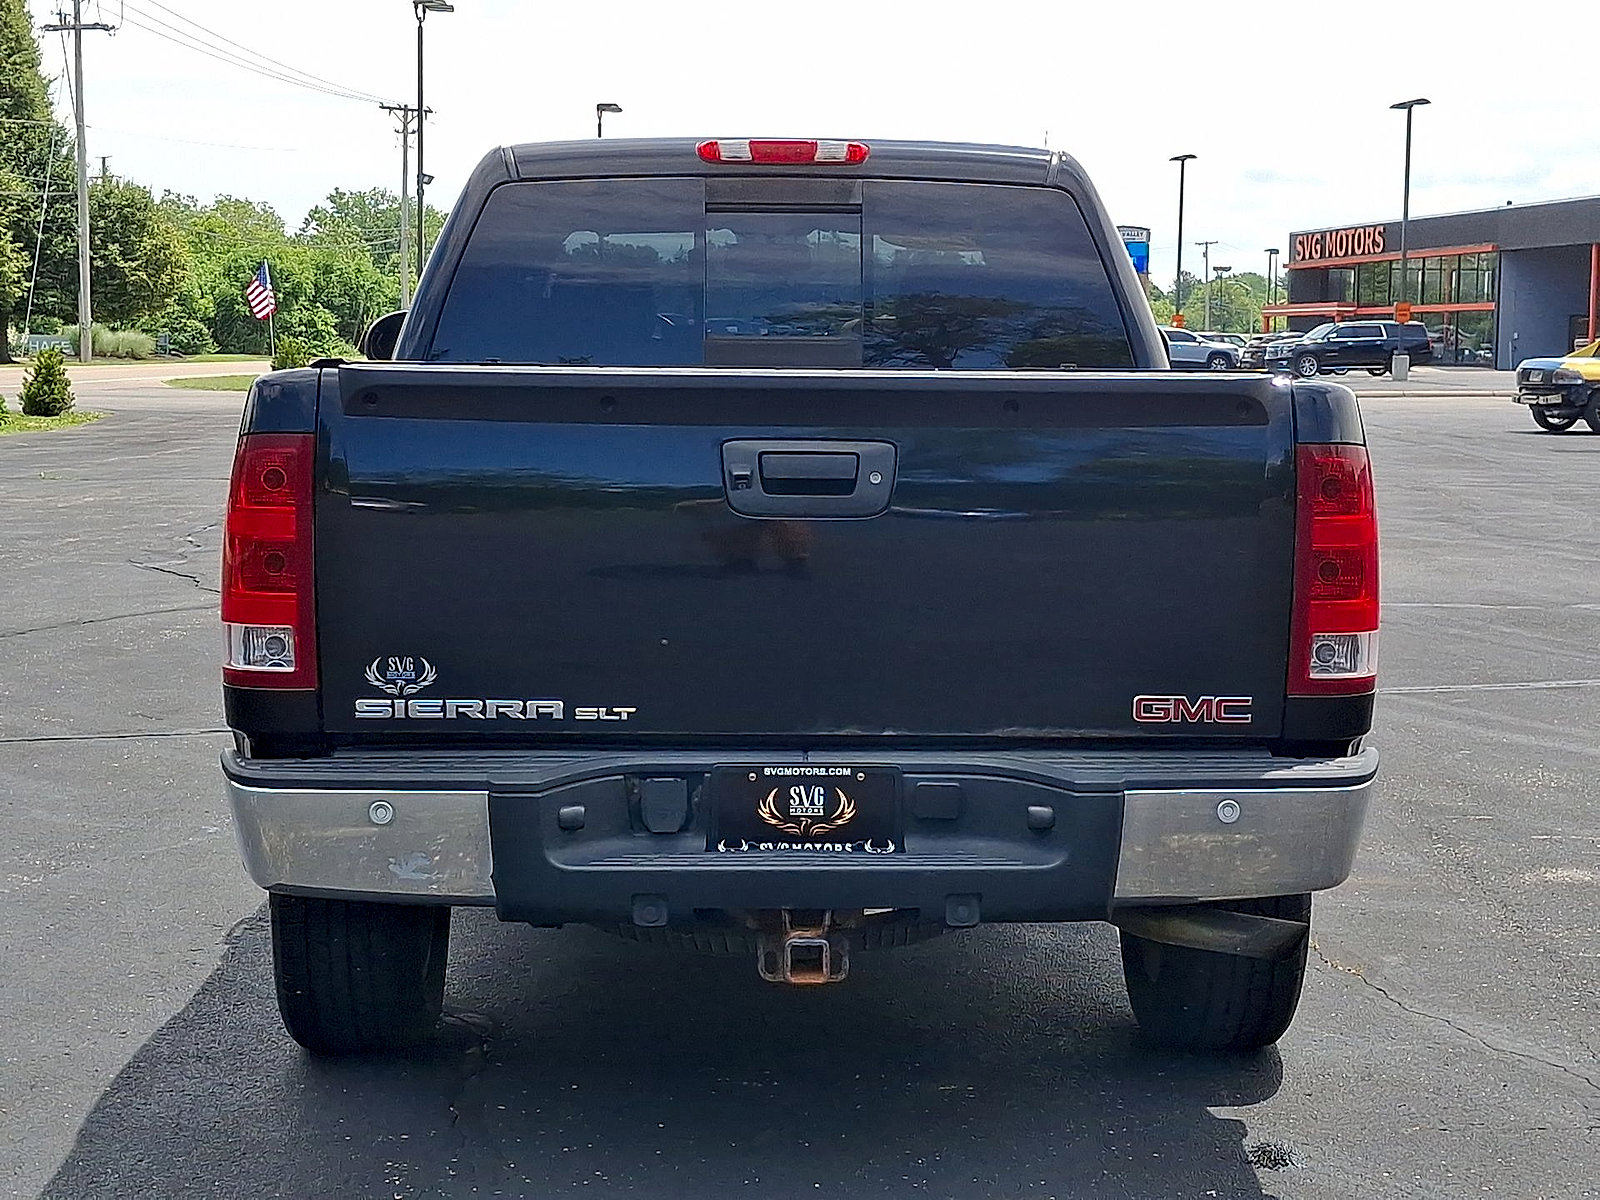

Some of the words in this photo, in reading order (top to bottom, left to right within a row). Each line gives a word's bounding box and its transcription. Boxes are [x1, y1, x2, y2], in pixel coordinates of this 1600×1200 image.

[1295, 233, 1321, 260] SVG
[1326, 226, 1384, 257] MOTORS
[388, 656, 413, 672] SVG
[355, 699, 564, 720] SIERRA
[575, 707, 637, 721] SLT
[1133, 695, 1252, 723] GMC
[763, 767, 852, 776] SVGMOTORS.COM
[789, 785, 824, 808] SVG
